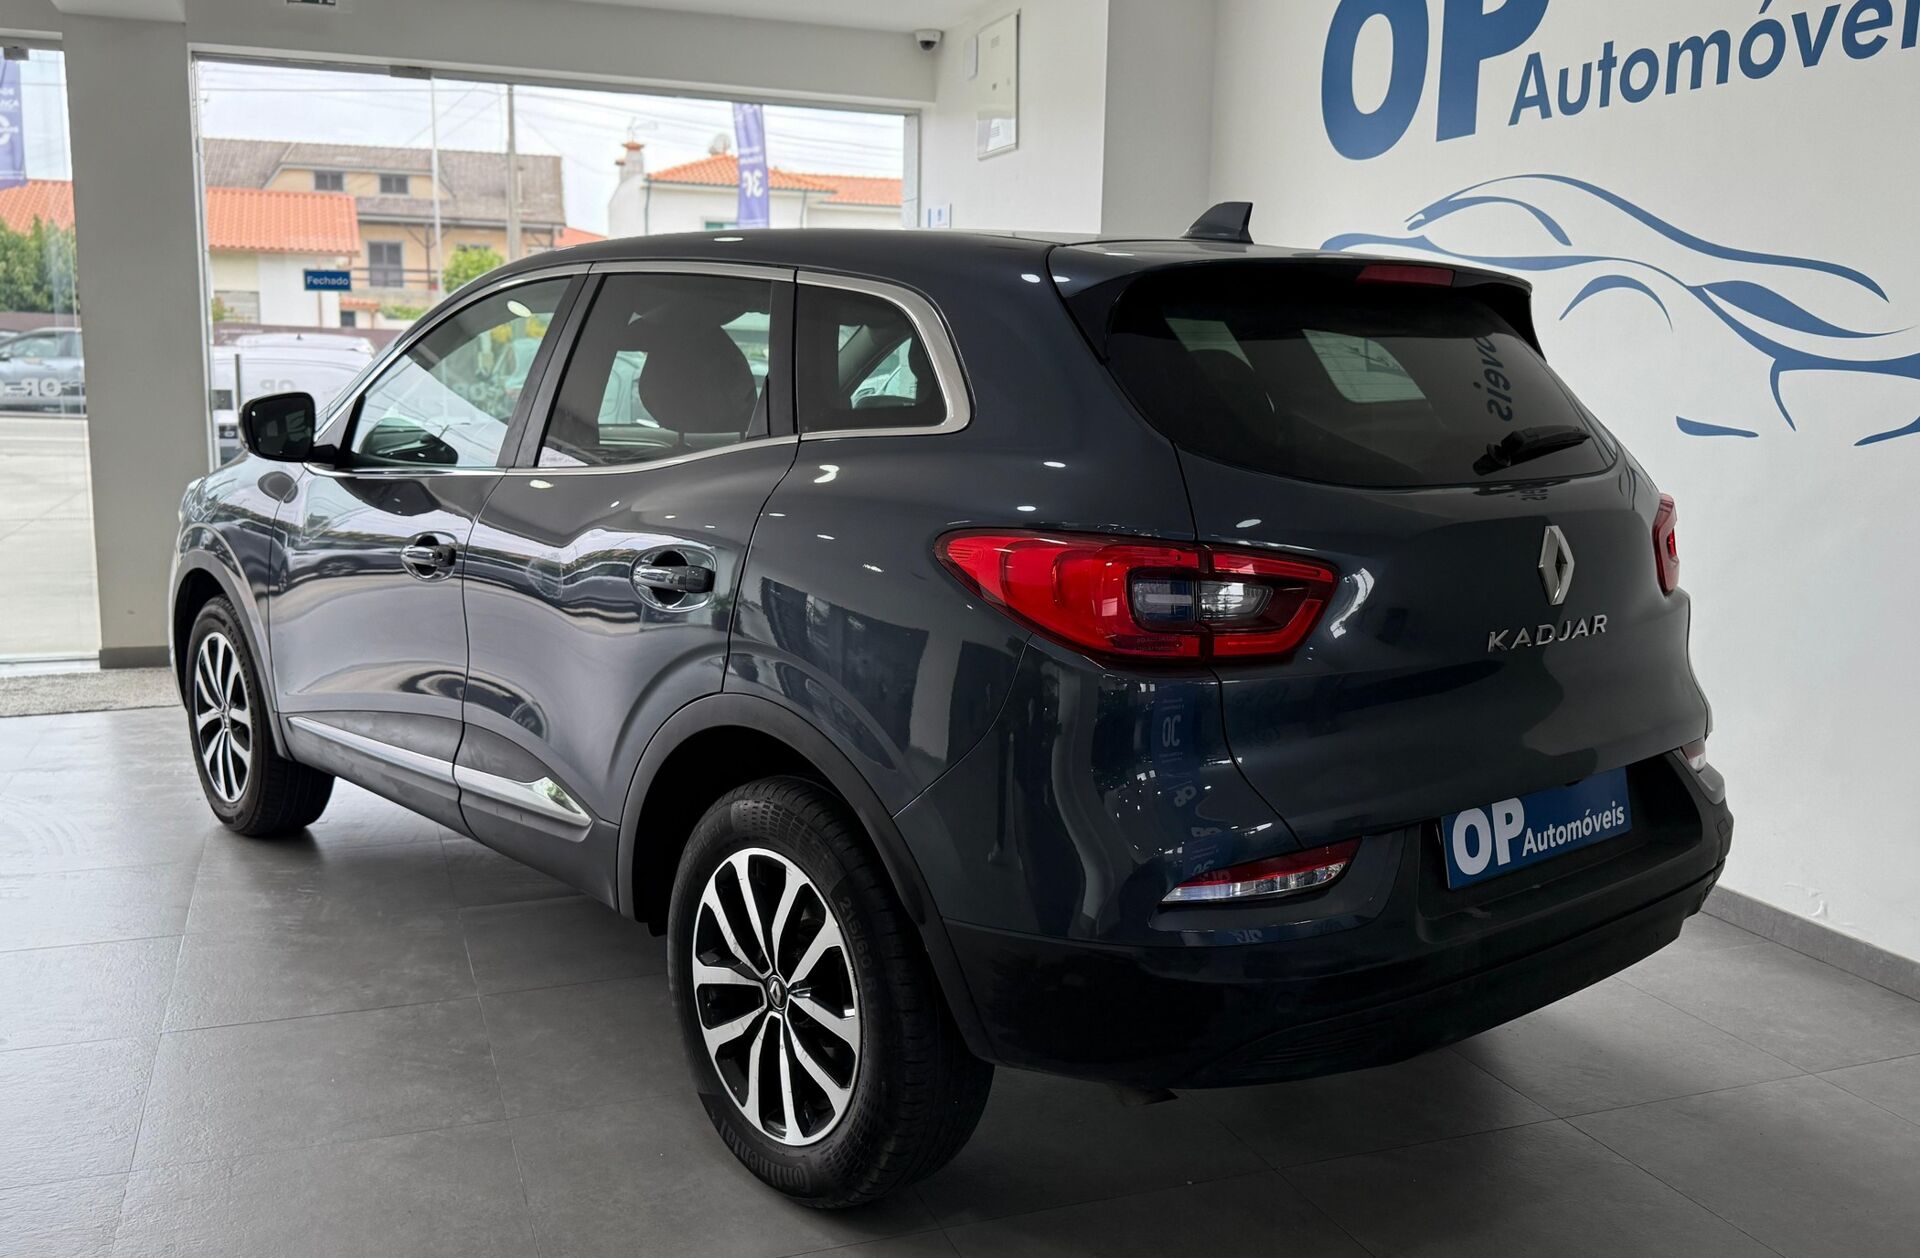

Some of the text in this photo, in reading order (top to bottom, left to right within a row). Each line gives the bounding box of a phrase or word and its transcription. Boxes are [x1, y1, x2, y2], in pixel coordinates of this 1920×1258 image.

[1321, 0, 1550, 160] OP
[307, 275, 349, 286] Fechado
[1488, 615, 1607, 652] KADJAR
[1452, 797, 1625, 875] OP Automóveis
